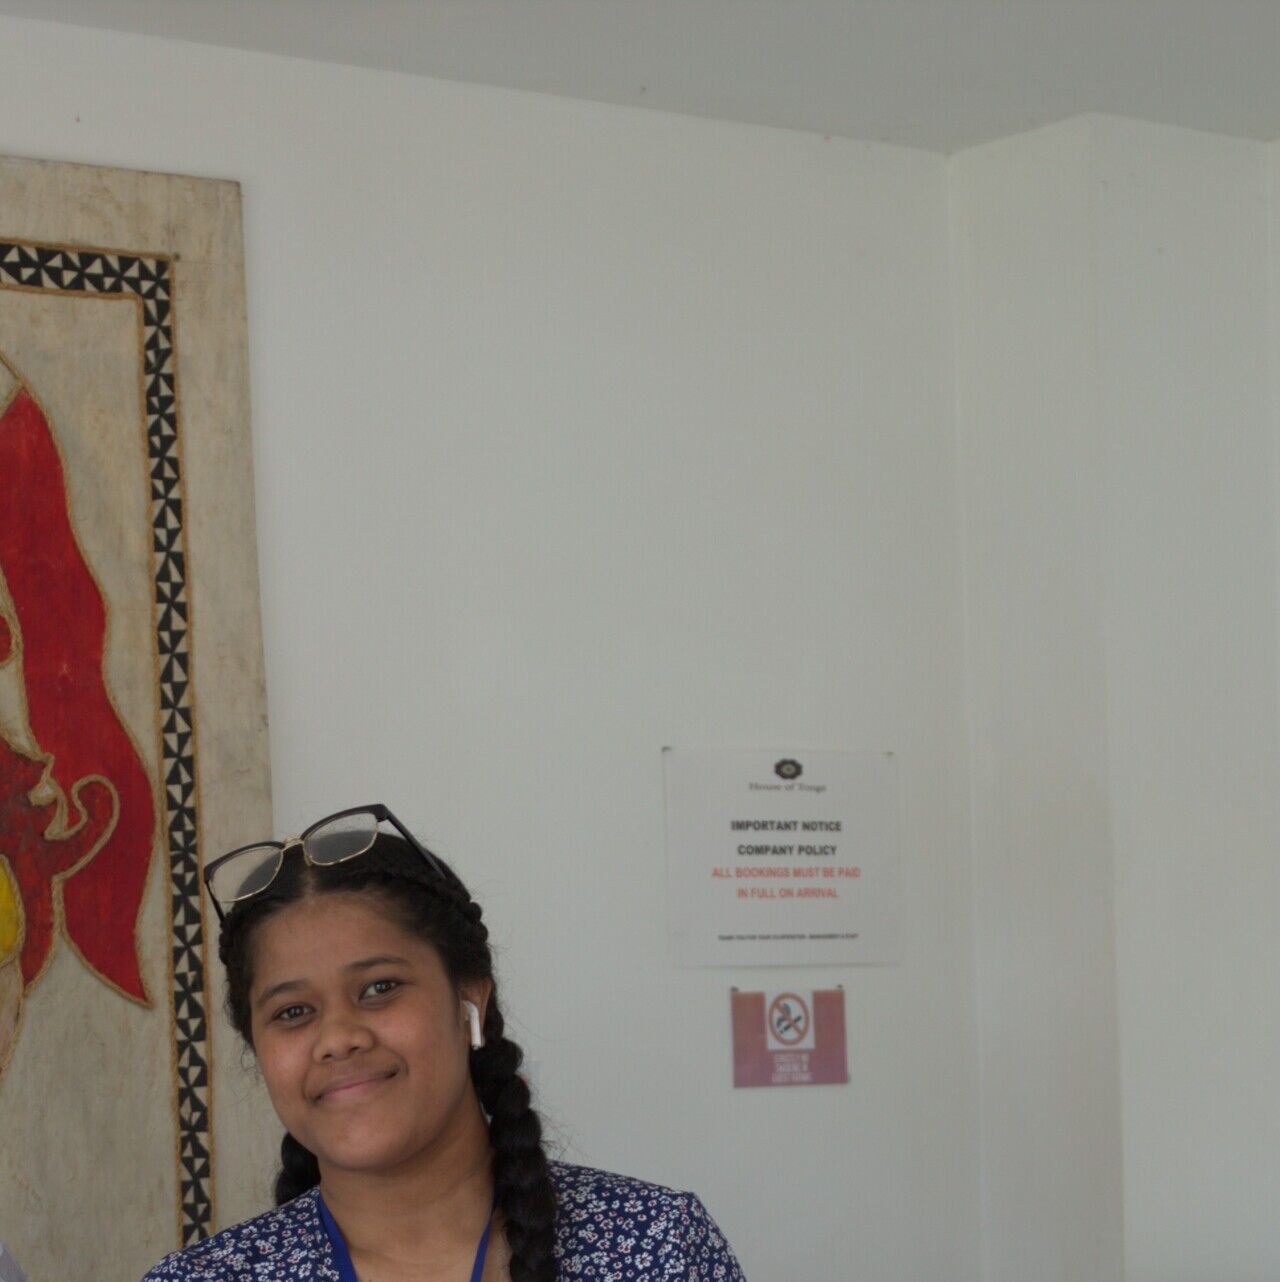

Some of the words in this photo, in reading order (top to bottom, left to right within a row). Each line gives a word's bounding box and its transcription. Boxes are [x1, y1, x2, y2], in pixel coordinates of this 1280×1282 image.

[731, 820, 799, 831] IMPORTANT
[802, 821, 842, 832] NOTICE
[737, 845, 795, 856] COMPANY
[798, 845, 837, 856] POLICY
[712, 867, 733, 878] ALL
[735, 867, 790, 878] BOOKINGS
[793, 867, 820, 878] MUST
[822, 867, 835, 878] BE
[838, 867, 862, 878] PAID
[737, 888, 748, 899] IN
[751, 888, 776, 898] FULL
[779, 888, 794, 898] ON
[797, 888, 839, 898] ARRIVAL
